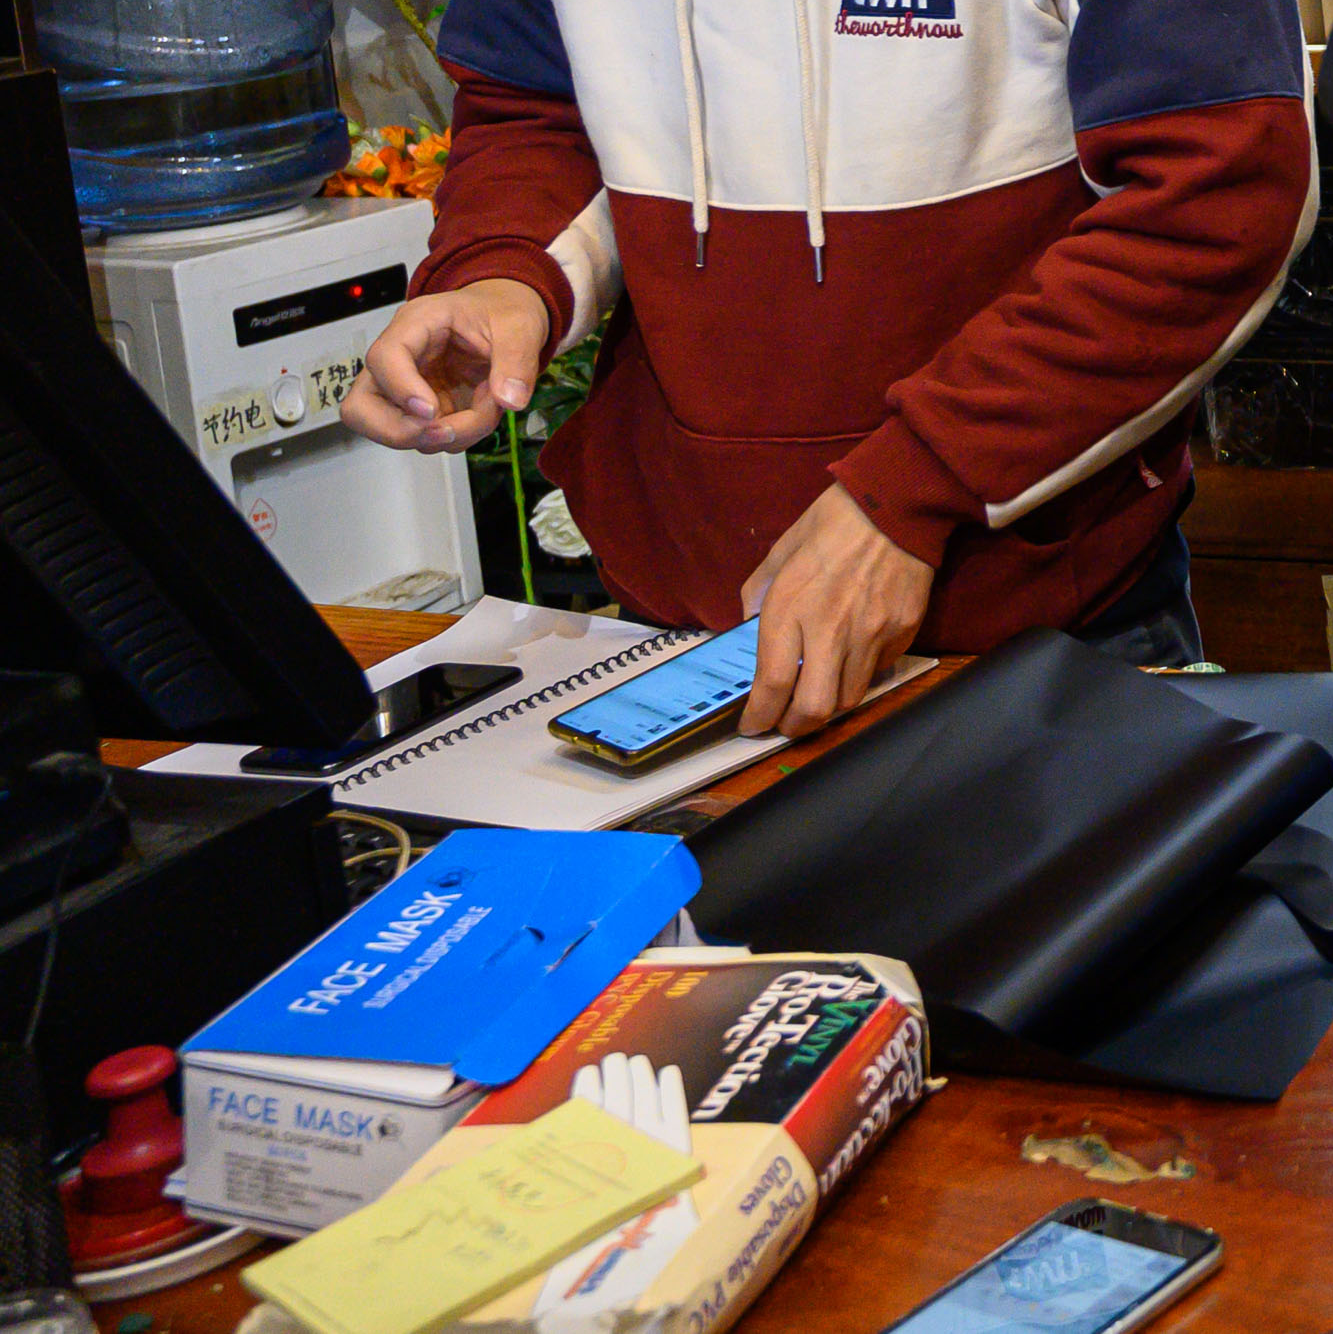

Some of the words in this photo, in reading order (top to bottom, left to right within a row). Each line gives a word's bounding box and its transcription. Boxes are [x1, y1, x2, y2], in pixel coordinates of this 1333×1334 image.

[203, 399, 266, 444] 节约电
[288, 960, 387, 1015] FACE
[364, 891, 463, 953] MASK
[785, 999, 879, 1067] VINYL
[208, 1086, 279, 1125] FACE
[295, 1103, 374, 1140] MASK
[739, 1155, 793, 1216] Gloves
